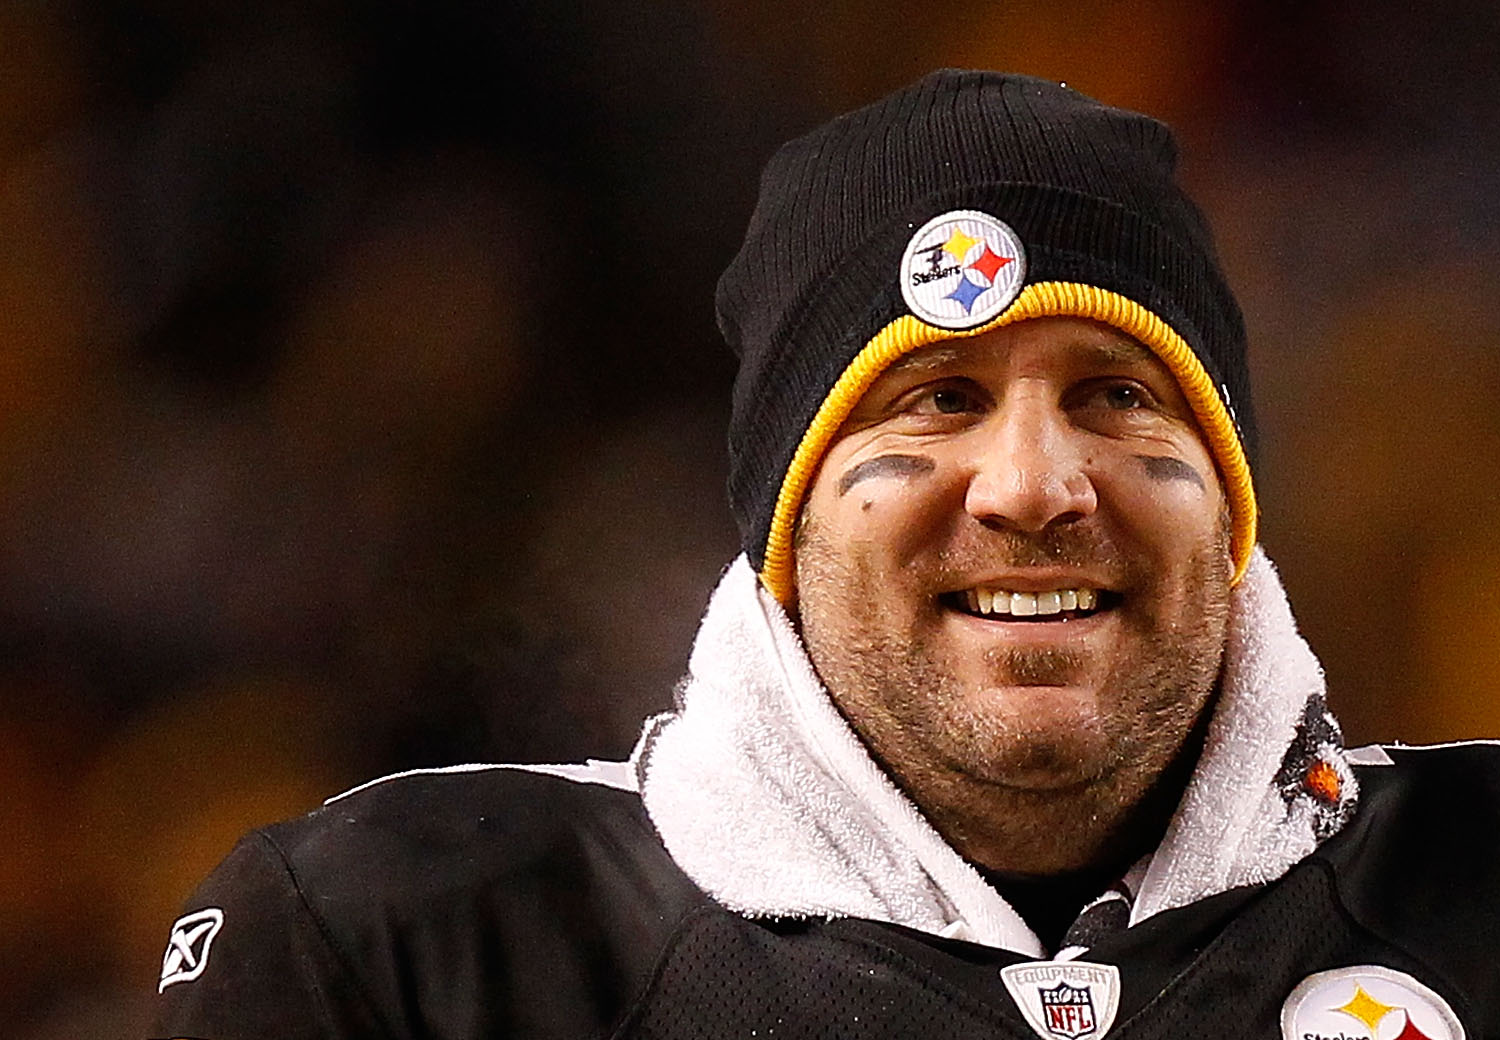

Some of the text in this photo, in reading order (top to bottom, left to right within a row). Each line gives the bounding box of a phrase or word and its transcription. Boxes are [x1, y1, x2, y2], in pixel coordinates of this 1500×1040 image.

[912, 264, 961, 286] Steelers
[1015, 968, 1107, 985] EQUIPMENT
[1048, 1005, 1091, 1033] NFL
